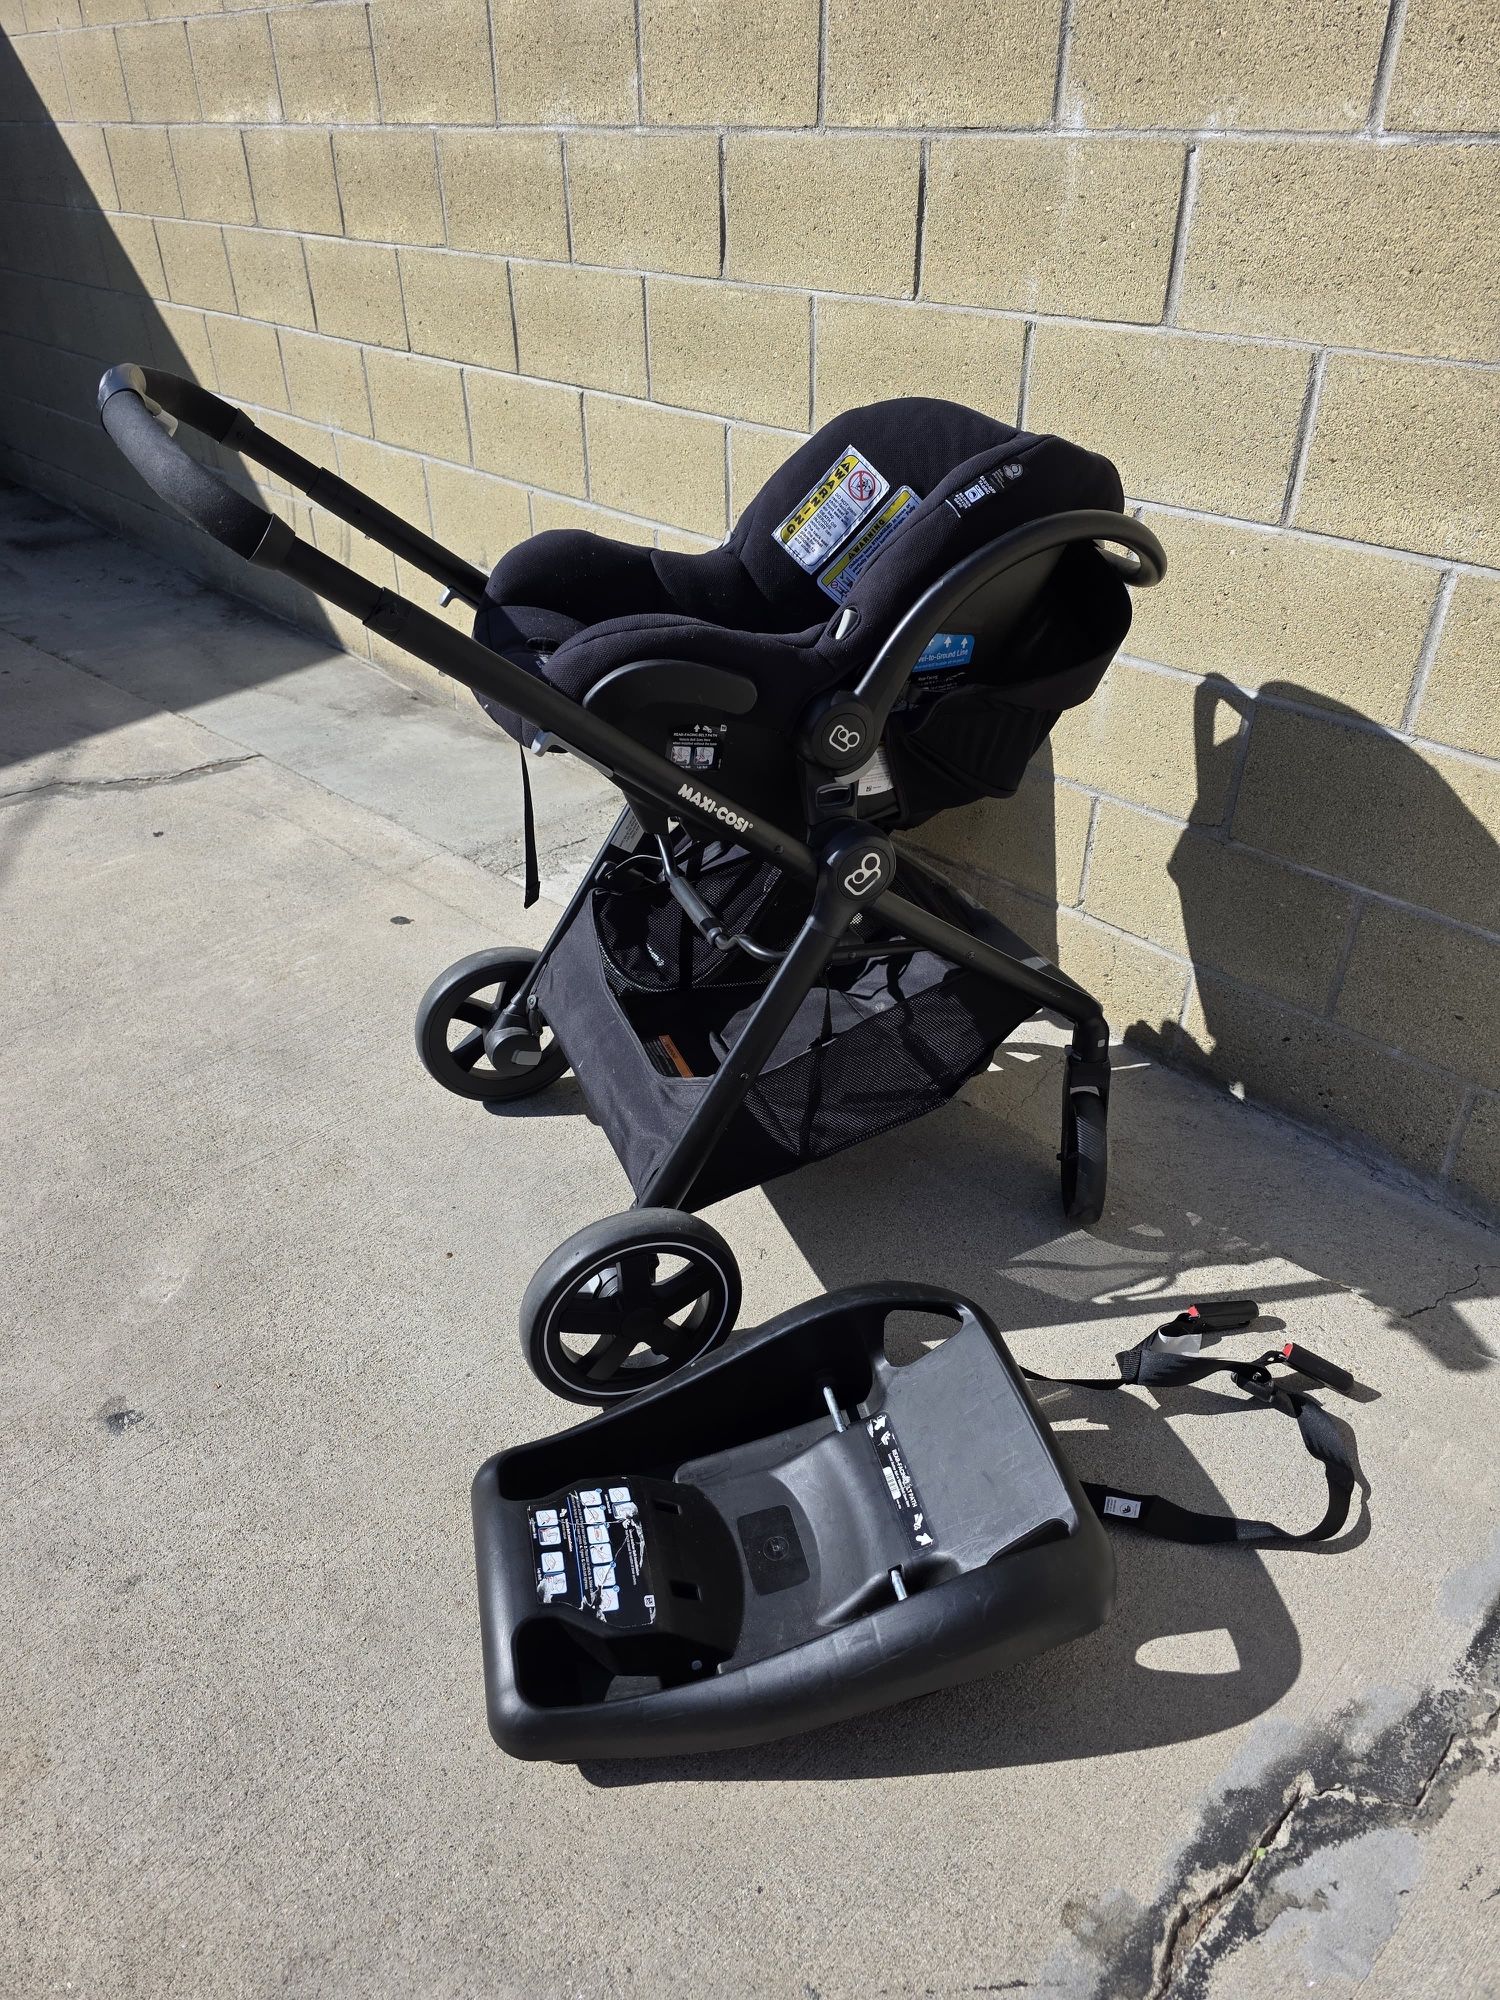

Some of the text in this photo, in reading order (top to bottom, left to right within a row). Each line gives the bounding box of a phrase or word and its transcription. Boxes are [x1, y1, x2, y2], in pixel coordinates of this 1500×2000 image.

[785, 467, 846, 534] WARNING
[852, 517, 885, 554] WARNING
[917, 648, 968, 662] vel-to-Ground Line
[908, 1492, 917, 1507] PATH
